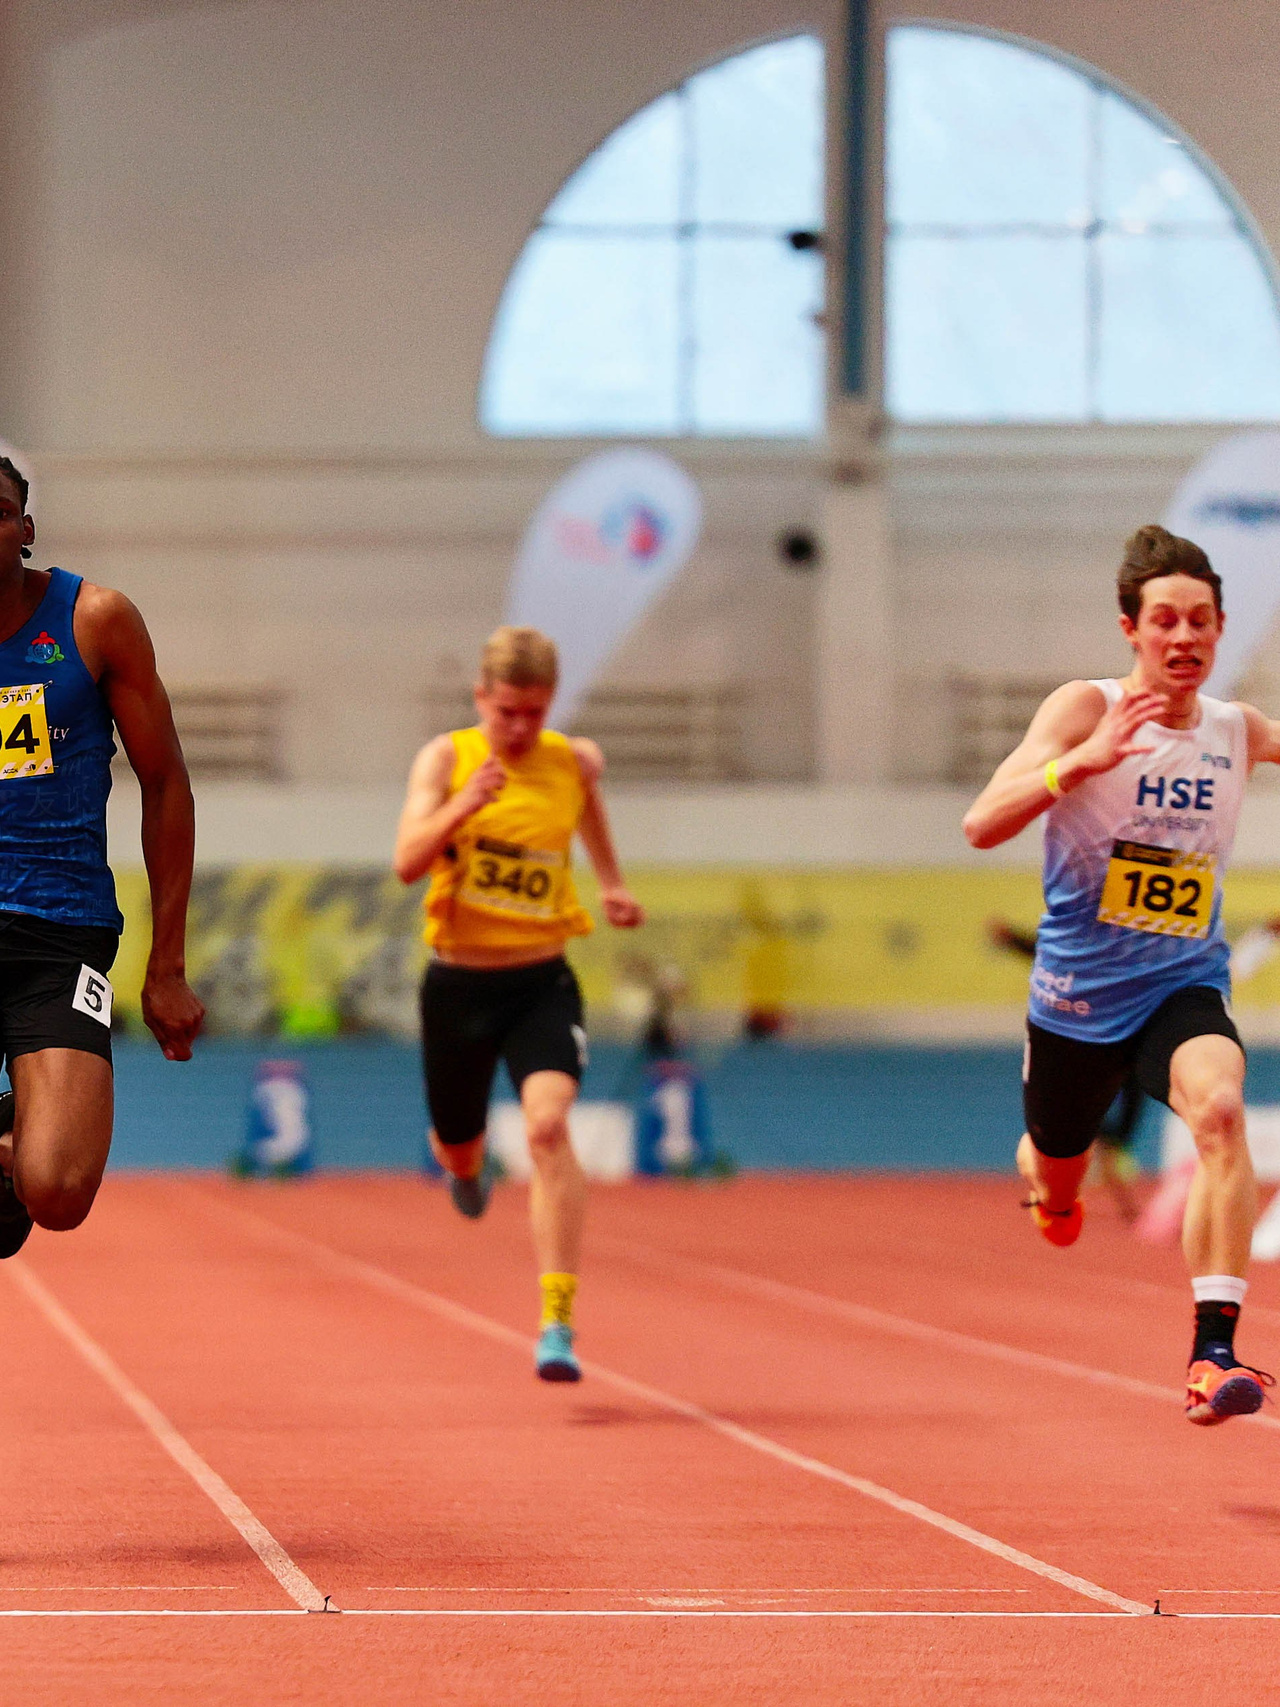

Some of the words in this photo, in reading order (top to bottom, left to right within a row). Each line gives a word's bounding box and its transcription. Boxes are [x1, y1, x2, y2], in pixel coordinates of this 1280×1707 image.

[1, 693, 32, 703] ЭТАП
[1136, 774, 1215, 810] HSE
[475, 860, 551, 899] 340
[1124, 870, 1201, 918] 182
[83, 975, 106, 1013] 5
[256, 1080, 308, 1164] 3
[656, 1080, 696, 1163] 1
